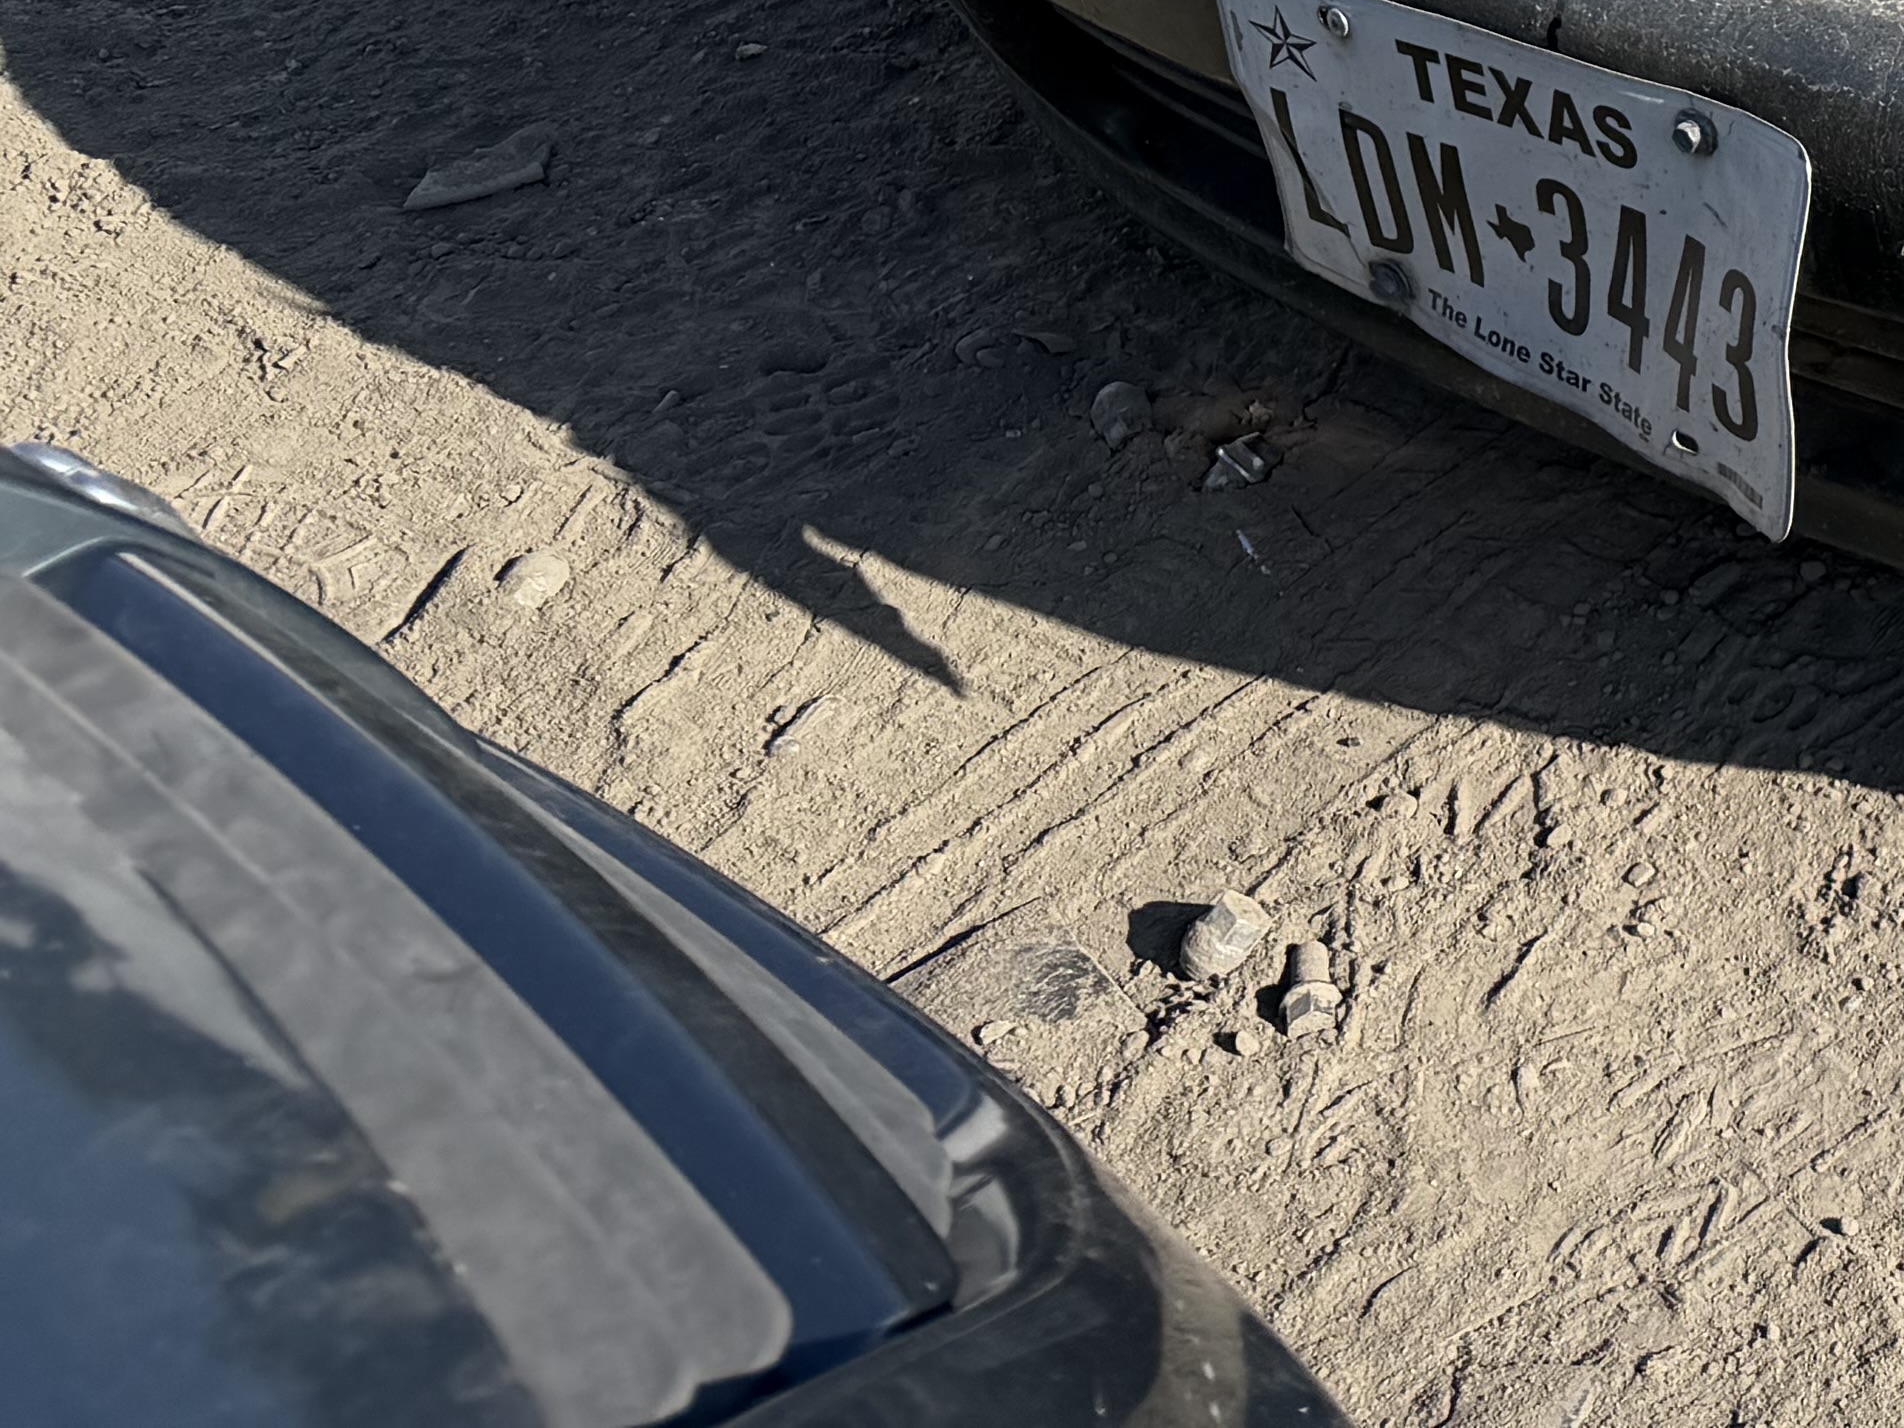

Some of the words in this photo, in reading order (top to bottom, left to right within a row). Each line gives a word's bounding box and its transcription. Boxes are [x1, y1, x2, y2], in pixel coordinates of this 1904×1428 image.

[1394, 38, 1638, 169] TEXAS
[1427, 287, 1468, 330] The
[1473, 314, 1532, 364] Lone
[1538, 351, 1592, 393] Star
[1598, 381, 1654, 437] State
